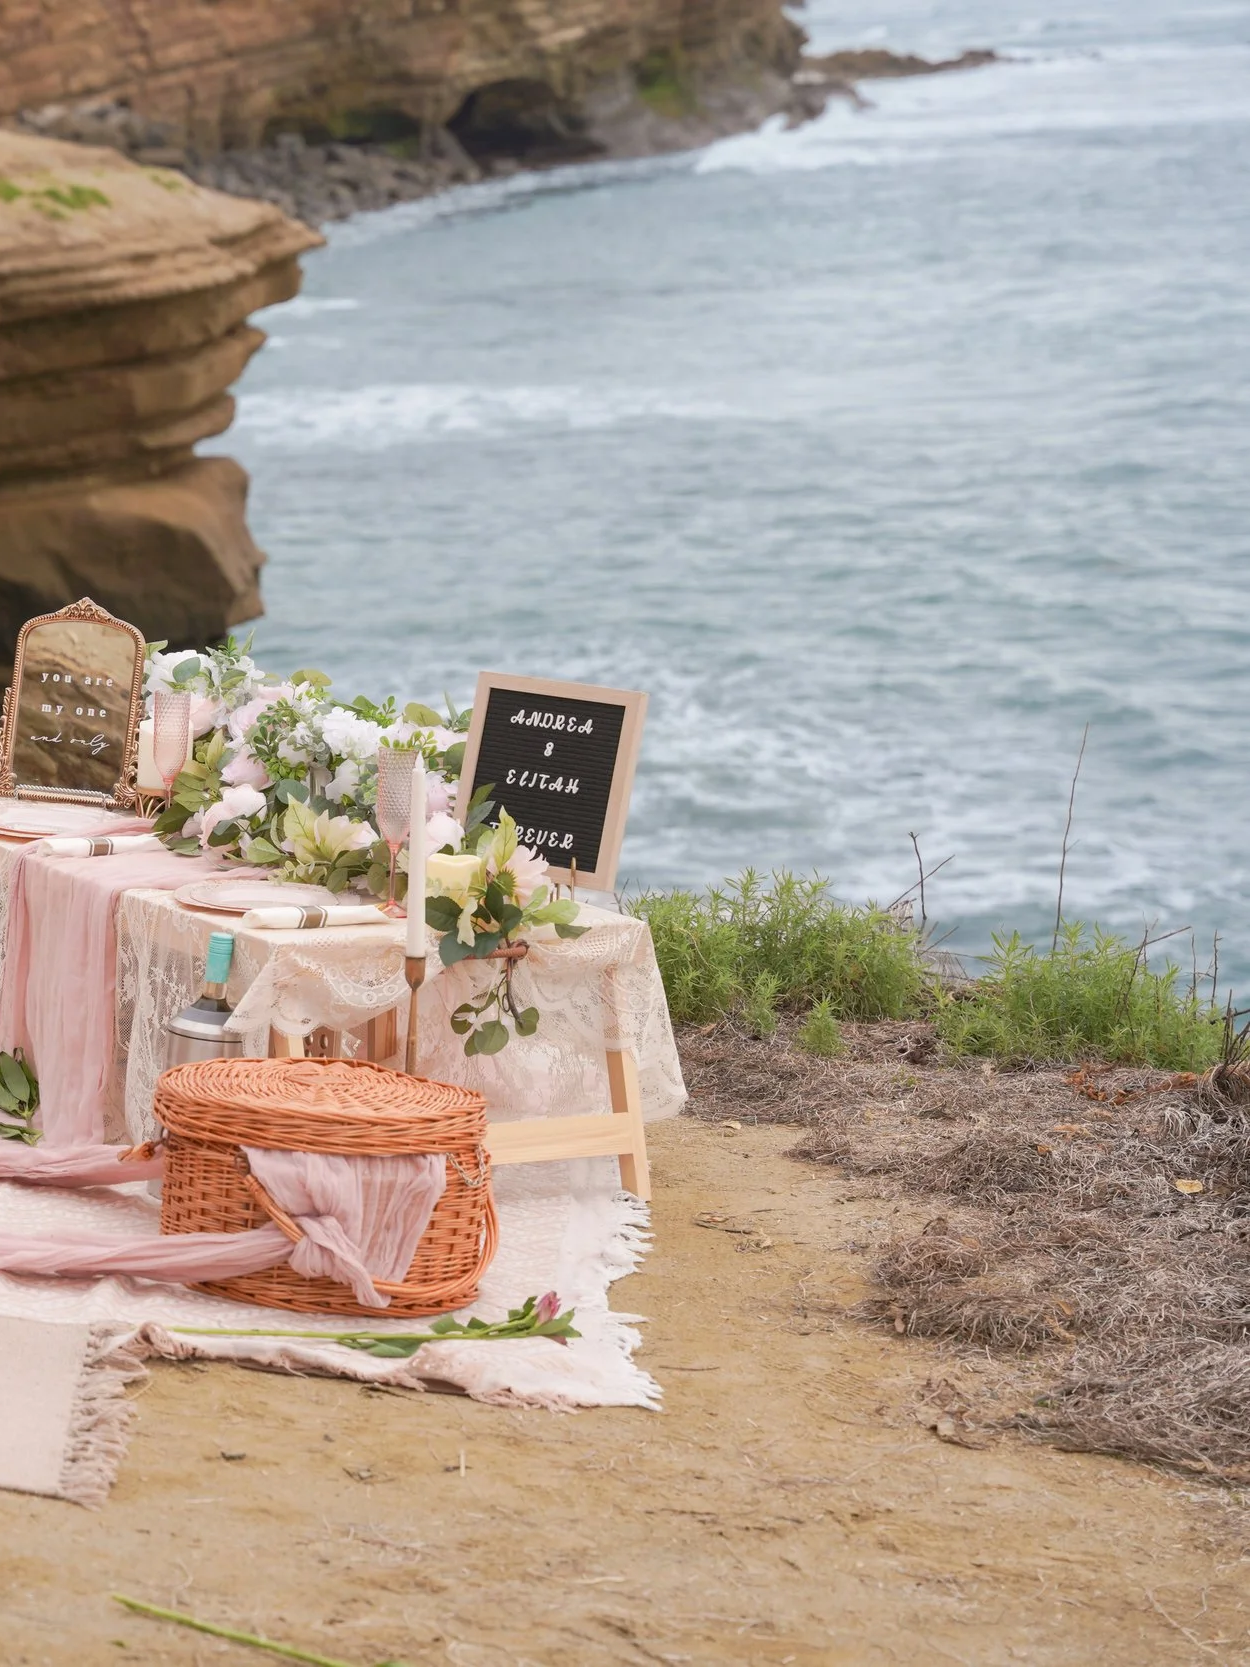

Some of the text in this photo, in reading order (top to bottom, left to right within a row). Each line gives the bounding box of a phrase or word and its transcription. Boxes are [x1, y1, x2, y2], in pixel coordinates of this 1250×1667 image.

[41, 672, 113, 687] you are
[41, 703, 107, 718] my one
[510, 709, 593, 734] ANDREA
[31, 732, 110, 755] and only
[489, 821, 574, 849] REVER
